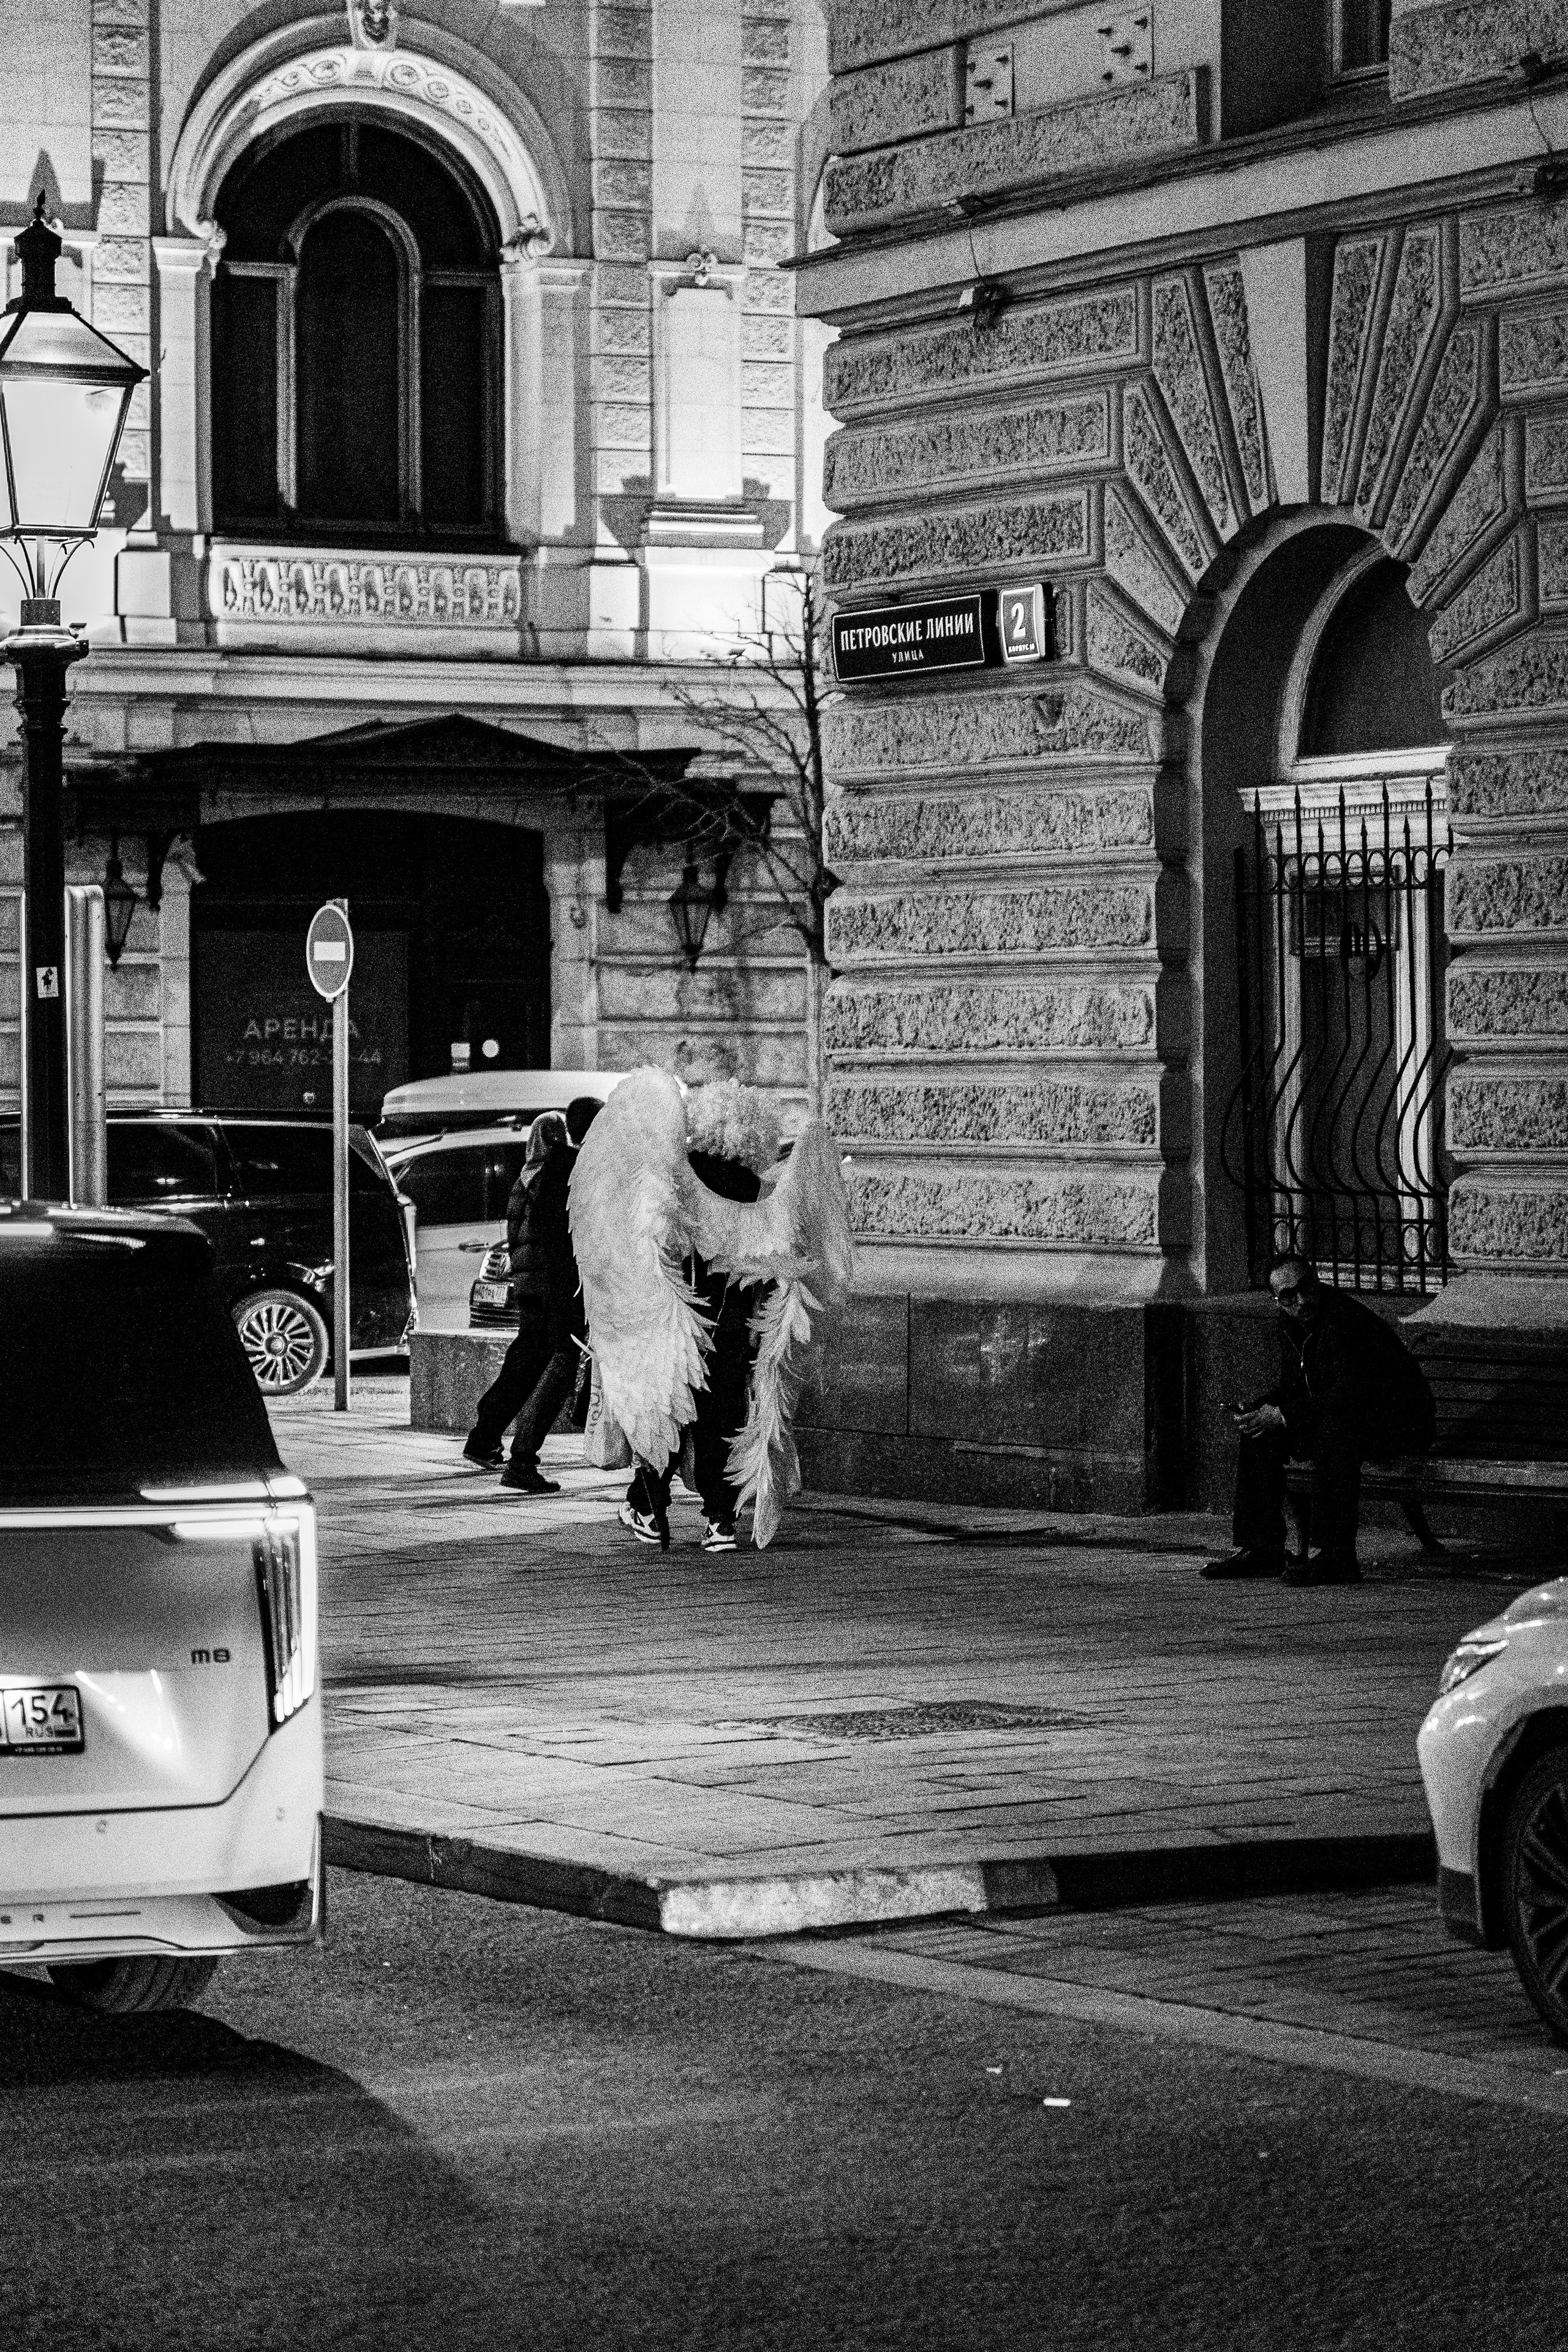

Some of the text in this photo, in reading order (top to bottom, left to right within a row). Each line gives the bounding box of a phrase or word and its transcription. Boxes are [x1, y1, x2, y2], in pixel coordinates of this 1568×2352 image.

[840, 612, 974, 651] ПЕТРОВСКИЕ ЛИНИИ
[1011, 602, 1026, 638] 2
[892, 649, 924, 663] УЛИЦА
[1008, 644, 1029, 652] КОРПУС
[243, 1017, 361, 1042] АРЕНДА
[11, 1693, 74, 1725] 154
[25, 1725, 53, 1738] RUS
